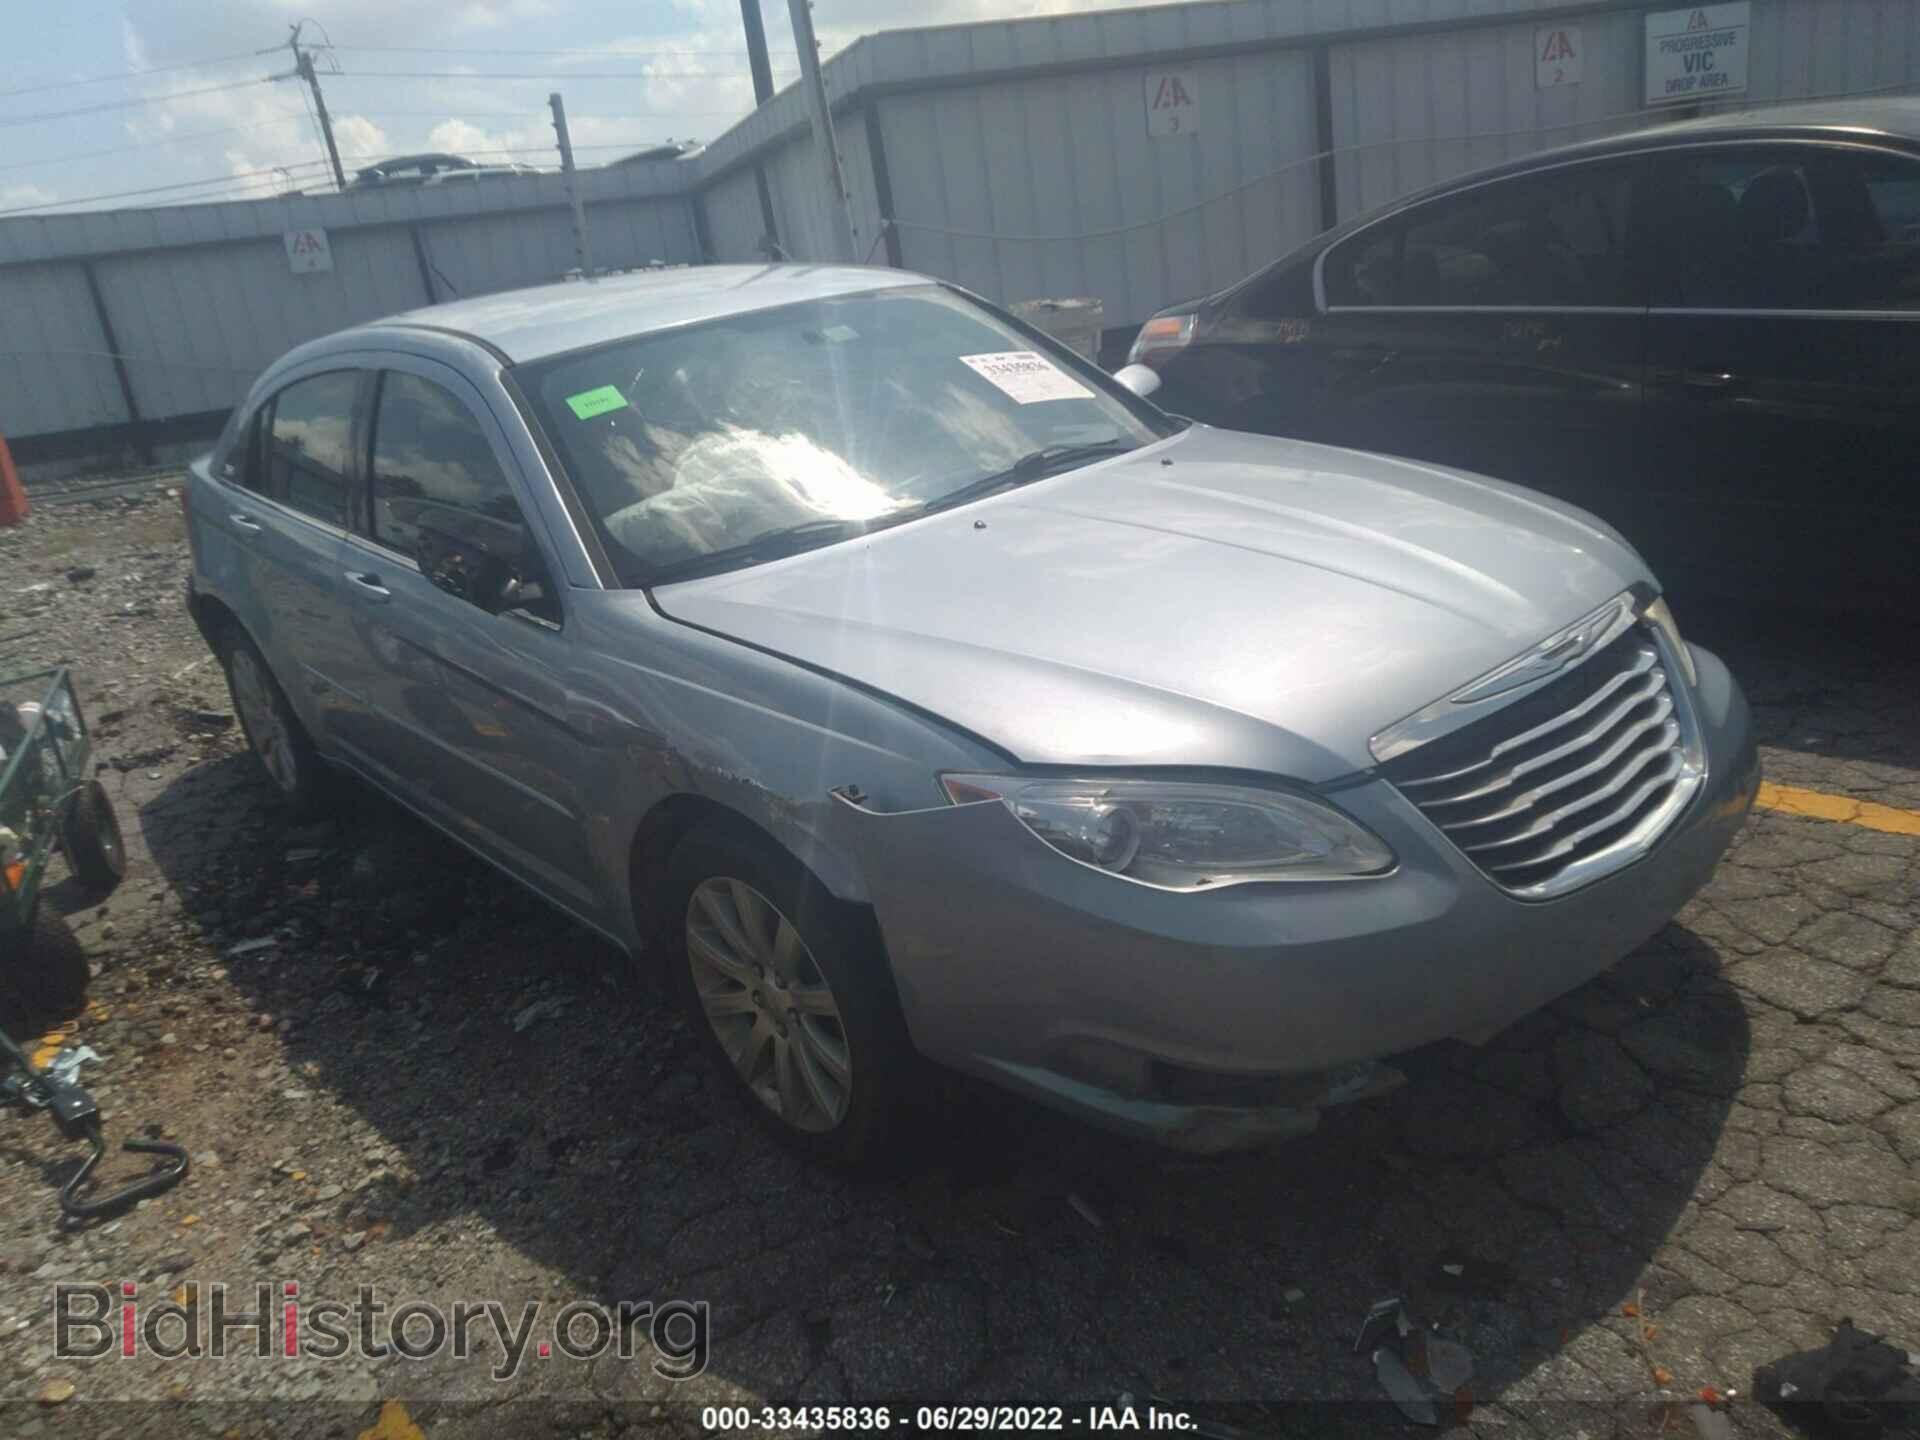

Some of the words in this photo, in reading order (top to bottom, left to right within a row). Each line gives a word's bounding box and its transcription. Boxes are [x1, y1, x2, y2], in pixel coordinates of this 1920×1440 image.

[1659, 31, 1737, 54] PROGRESSIVE
[1683, 51, 1713, 73] VIC
[1664, 75, 1697, 94] DROP
[1699, 72, 1728, 89] AREA
